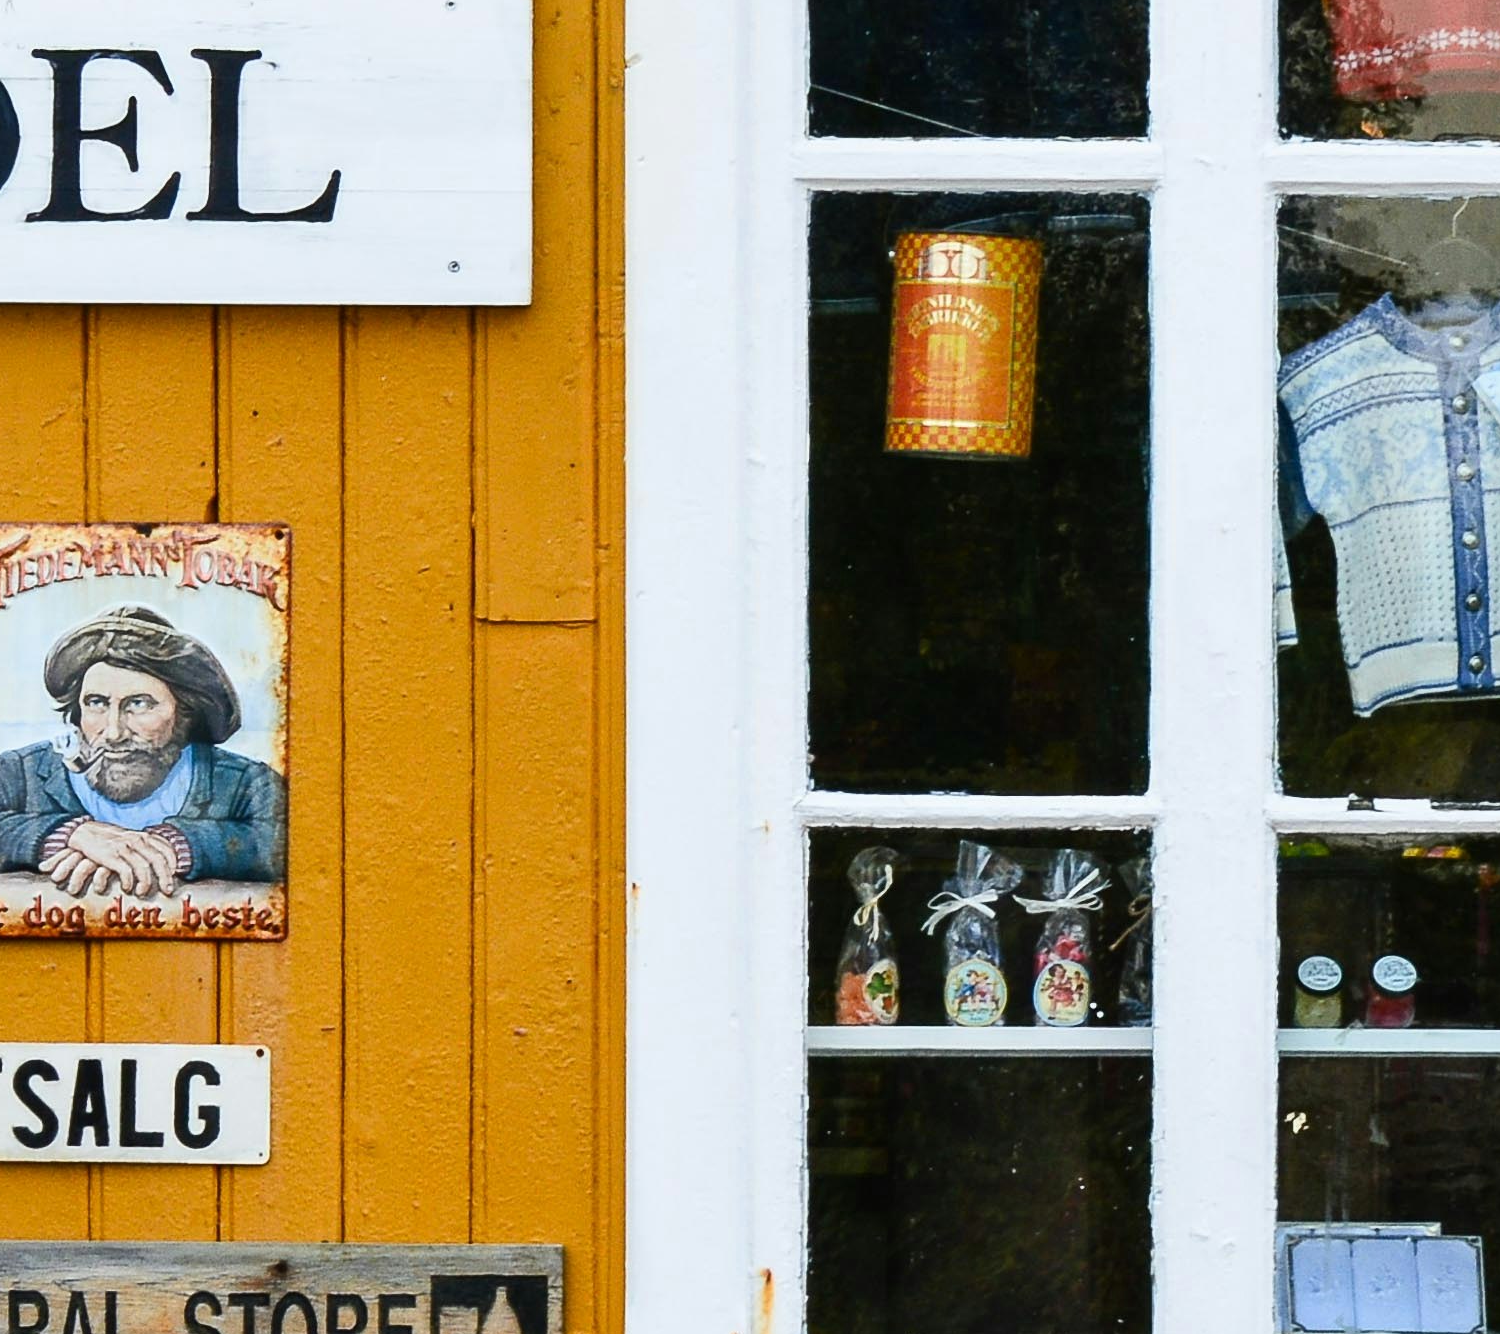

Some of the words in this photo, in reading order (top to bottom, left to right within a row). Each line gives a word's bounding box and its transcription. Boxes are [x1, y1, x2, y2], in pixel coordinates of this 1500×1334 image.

[172, 531, 286, 613] TOBAK
[22, 894, 86, 936] dog
[103, 894, 166, 930] den
